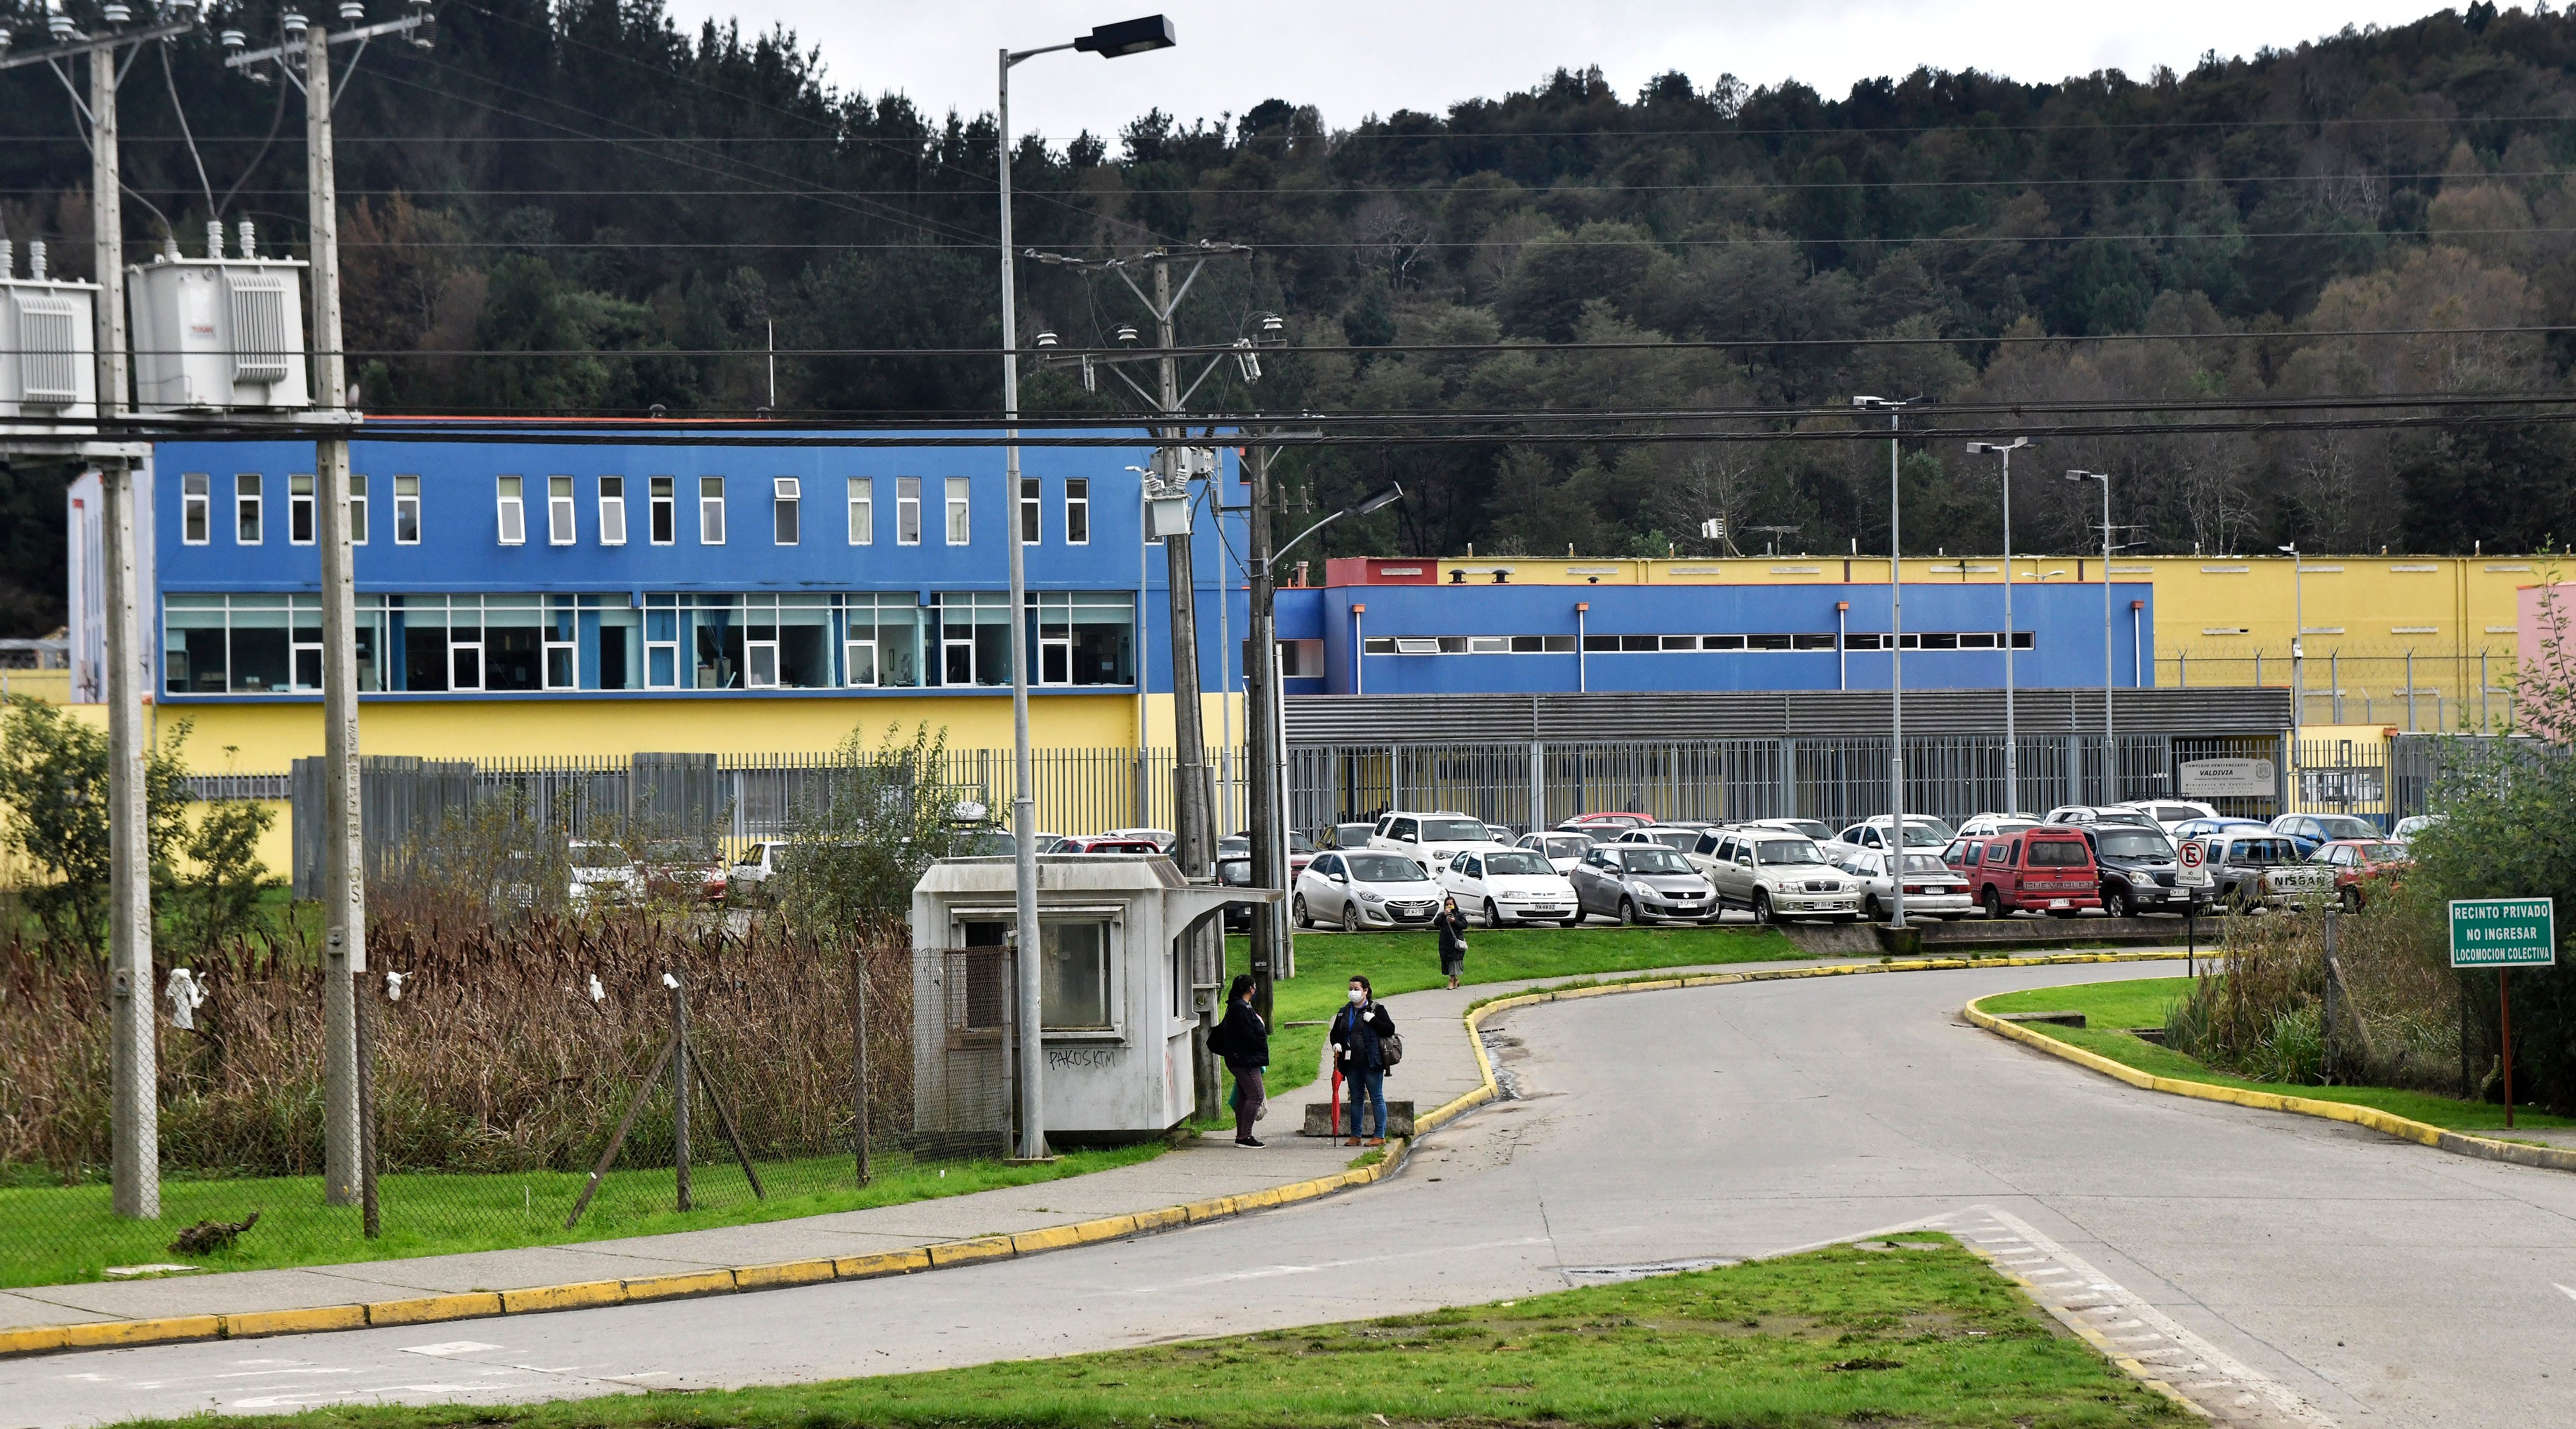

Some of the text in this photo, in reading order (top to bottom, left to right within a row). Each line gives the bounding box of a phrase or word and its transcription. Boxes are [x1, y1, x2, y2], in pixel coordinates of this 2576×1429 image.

[2455, 904, 2548, 920] RECINTO PRIVADO
[2466, 927, 2537, 941] NO INGRESAR
[2455, 946, 2549, 961] LOCOMOCION COLECTIVA
